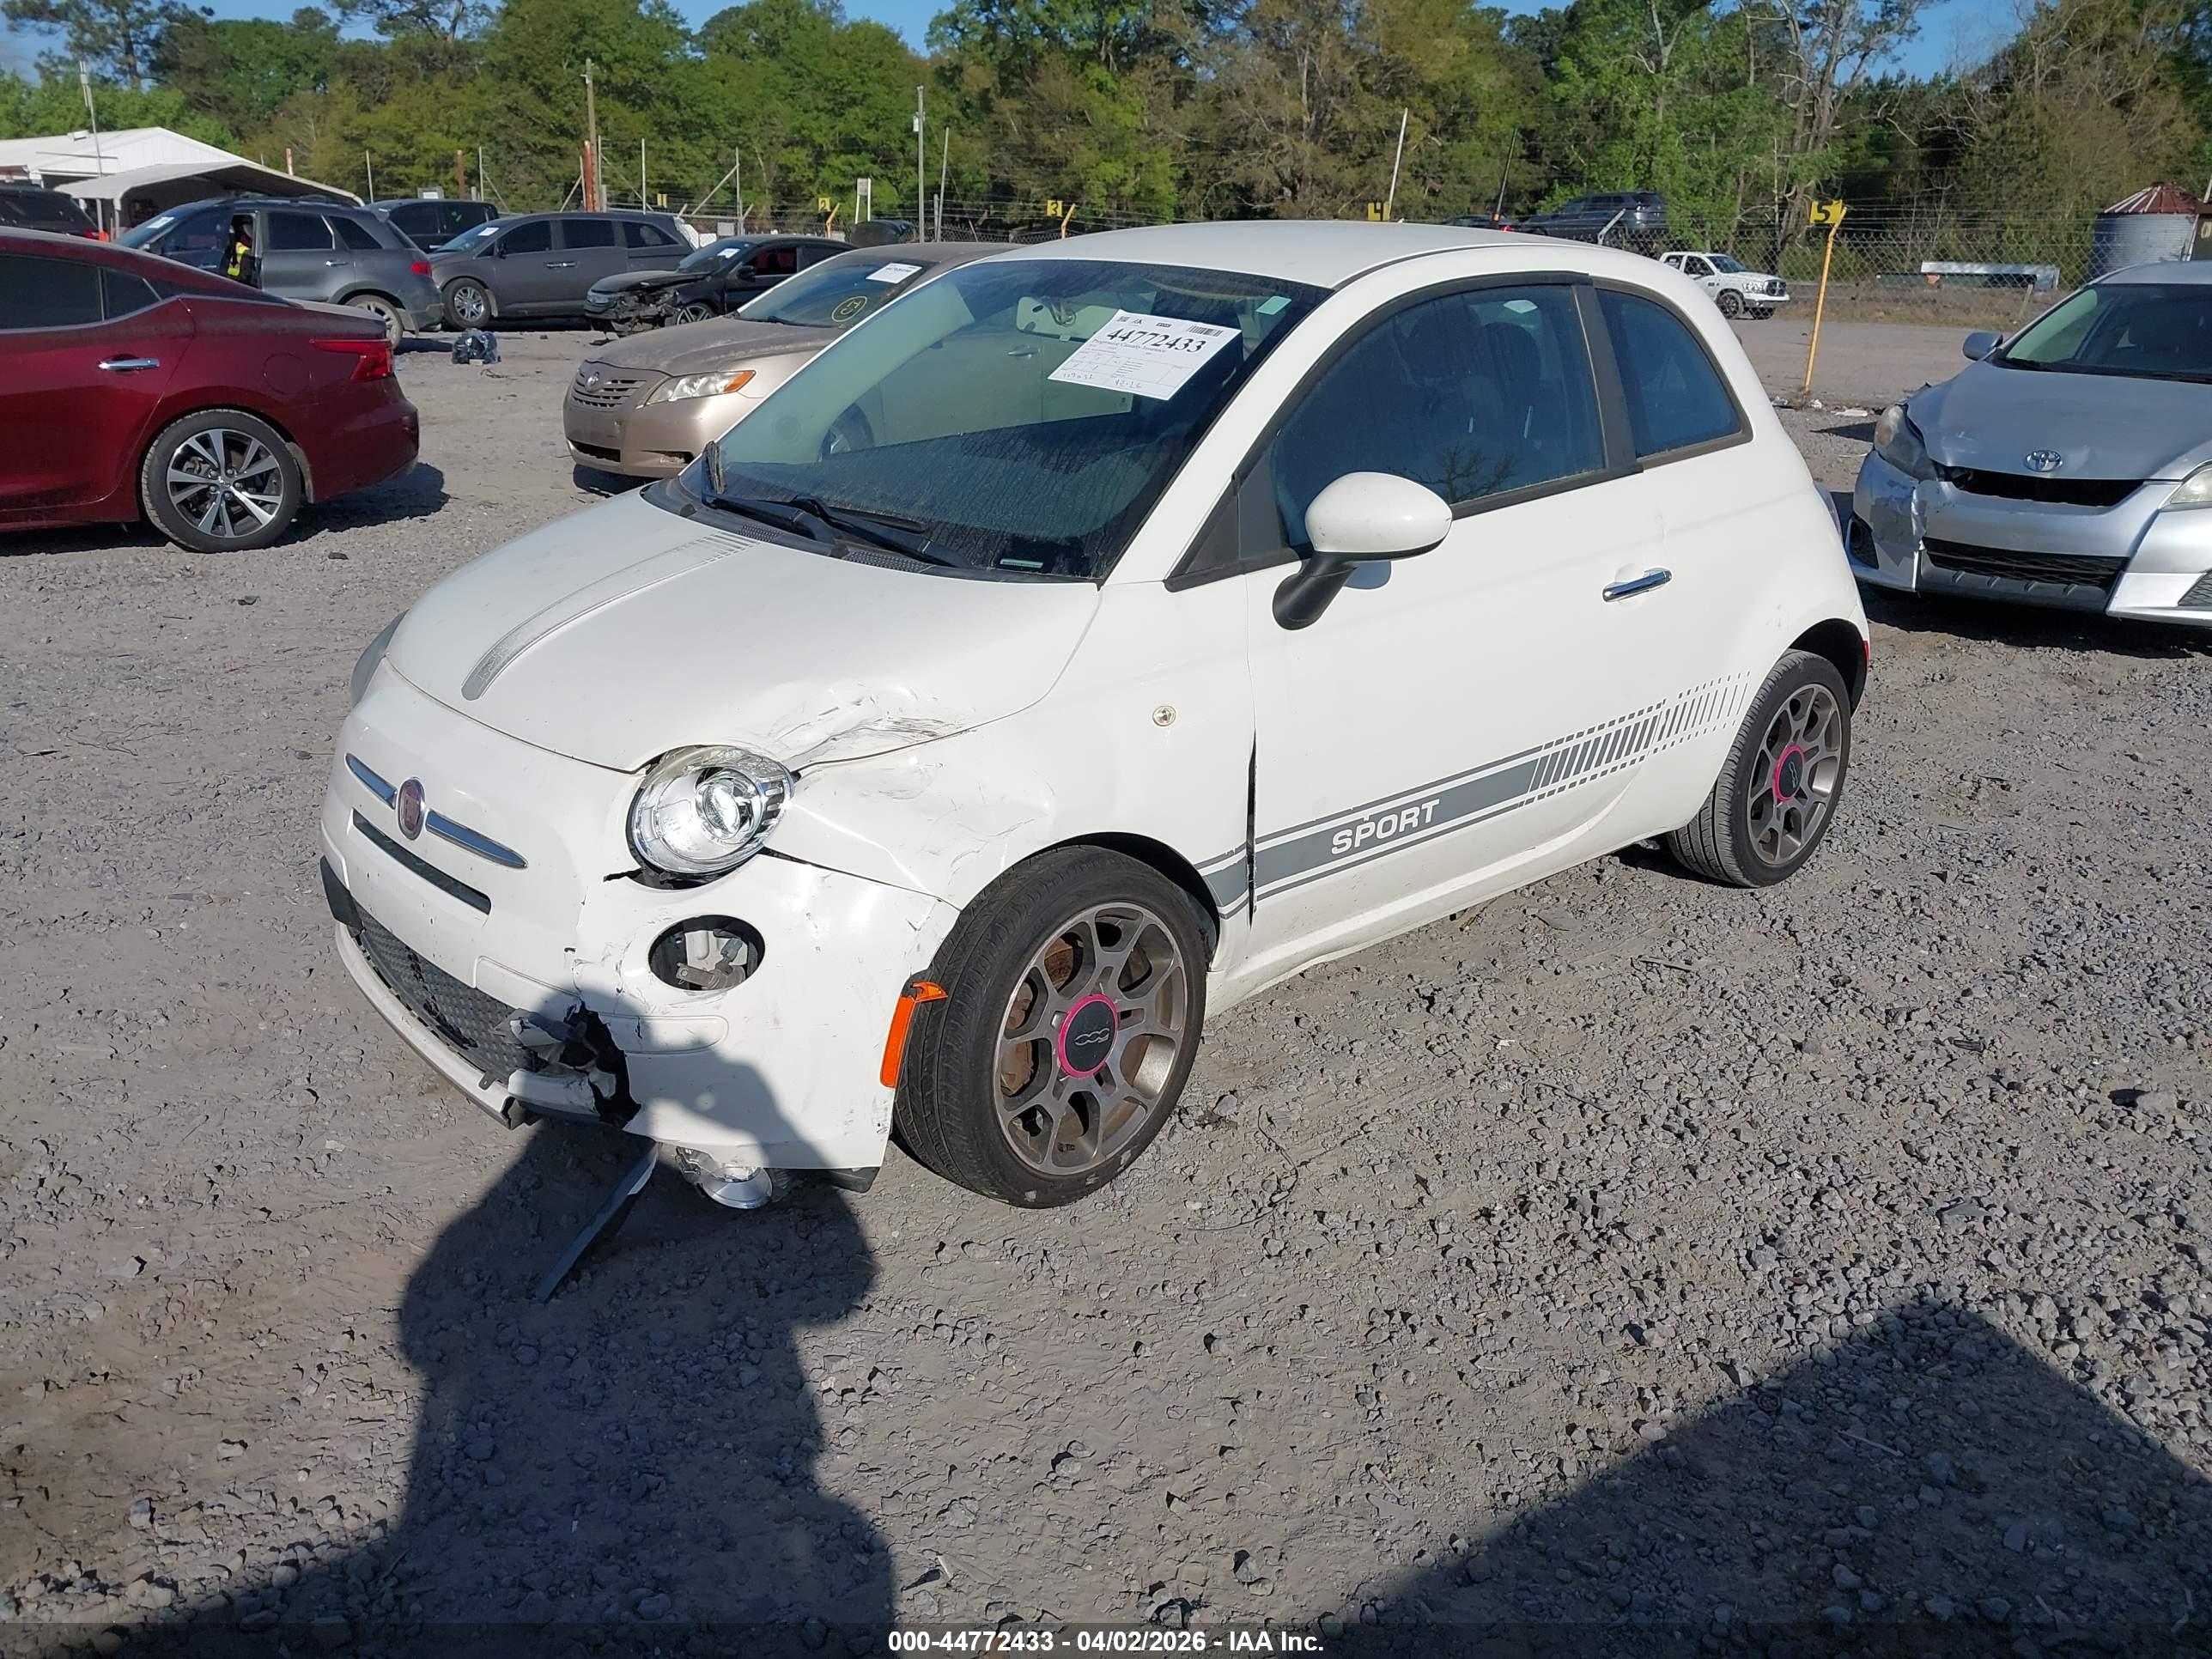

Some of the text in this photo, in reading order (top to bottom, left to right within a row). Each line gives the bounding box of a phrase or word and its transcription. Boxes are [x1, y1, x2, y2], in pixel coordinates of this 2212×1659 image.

[1050, 202, 1059, 216] 3
[1374, 200, 1383, 222] 4
[1814, 201, 1832, 222] 5
[1106, 328, 1206, 353] 44772433
[1331, 799, 1440, 854] SPORT
